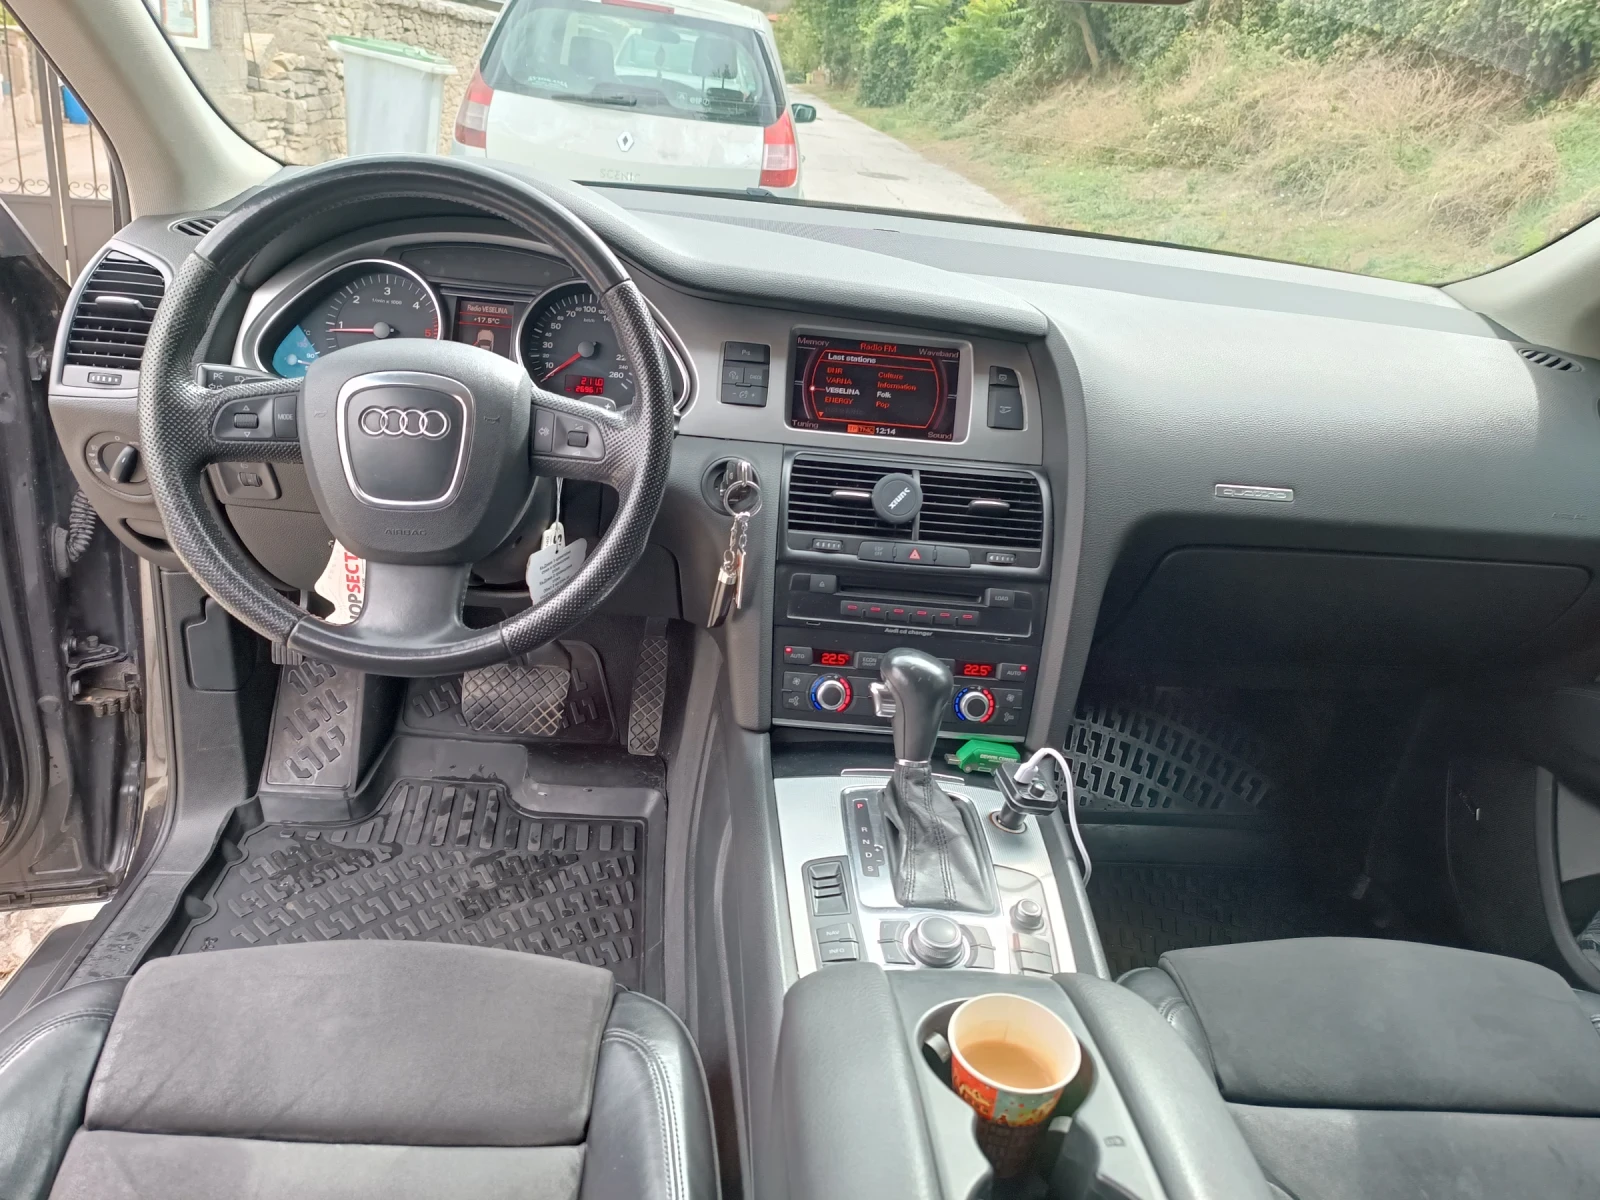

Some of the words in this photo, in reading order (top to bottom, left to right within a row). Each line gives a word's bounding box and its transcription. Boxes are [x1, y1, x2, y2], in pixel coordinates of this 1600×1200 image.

[599, 167, 640, 182] SCENIC
[383, 287, 391, 295] 3
[352, 295, 360, 304] 2
[412, 301, 420, 309] 4
[583, 305, 596, 313] 100
[566, 310, 576, 318] 70
[338, 320, 343, 329] 1
[550, 322, 561, 330] 50
[424, 328, 432, 337] 5
[542, 341, 553, 349] 30
[797, 337, 830, 347] Memory
[860, 342, 883, 351] Radio
[884, 344, 897, 353] FM
[919, 348, 959, 358] Waveband
[828, 353, 845, 361] Last
[846, 356, 876, 364] stations
[608, 371, 624, 379] 260
[878, 371, 904, 380] Culture
[877, 381, 917, 391] Information
[825, 387, 860, 395] VESELINA
[876, 391, 892, 399] Folk
[824, 397, 854, 405] ENERGY
[875, 401, 890, 409] Pop
[277, 413, 294, 421] MODE
[792, 420, 819, 430] Tuning
[875, 427, 896, 435] 12:14
[927, 431, 953, 440] Sound
[384, 528, 427, 537] AIRBAG
[994, 594, 1009, 602] LOAD
[908, 629, 933, 637] changer
